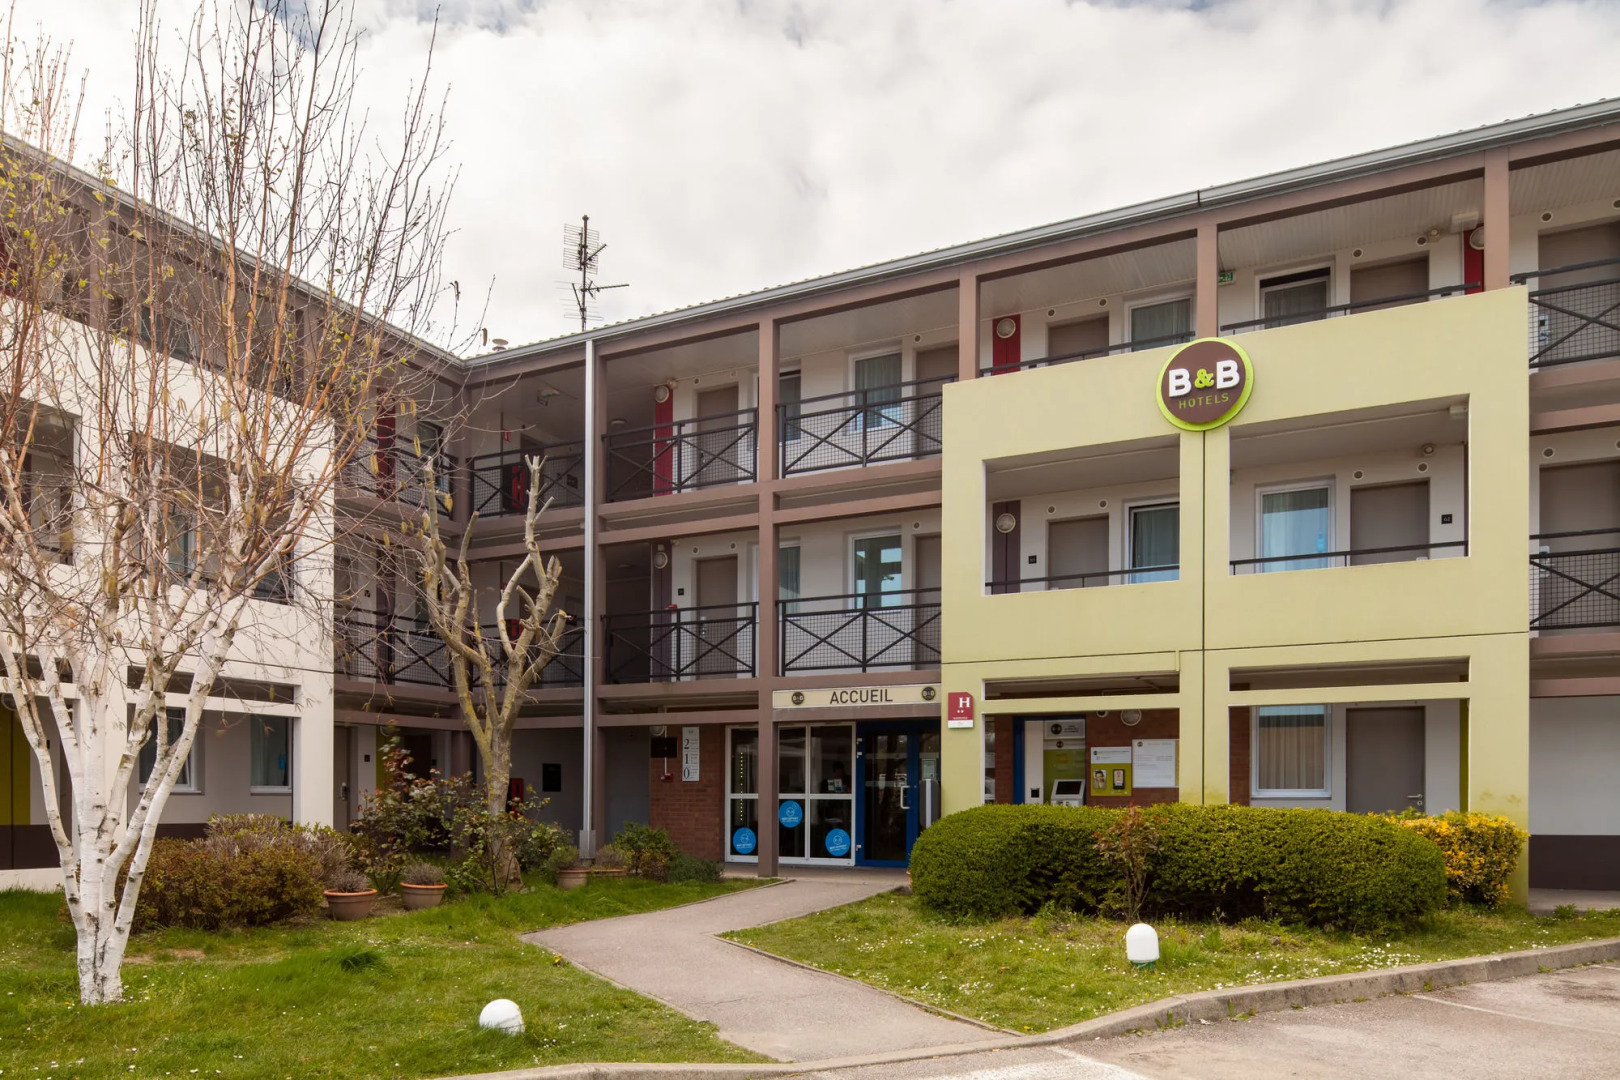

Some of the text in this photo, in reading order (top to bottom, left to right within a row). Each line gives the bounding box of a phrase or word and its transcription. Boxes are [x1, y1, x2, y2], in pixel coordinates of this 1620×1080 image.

[1169, 360, 1240, 397] B&B
[1179, 393, 1230, 409] HOTELS
[829, 689, 893, 704] ACCUEIL
[959, 697, 971, 708] H
[684, 738, 690, 750] 2
[685, 754, 689, 764] 1
[683, 767, 690, 779] 0
